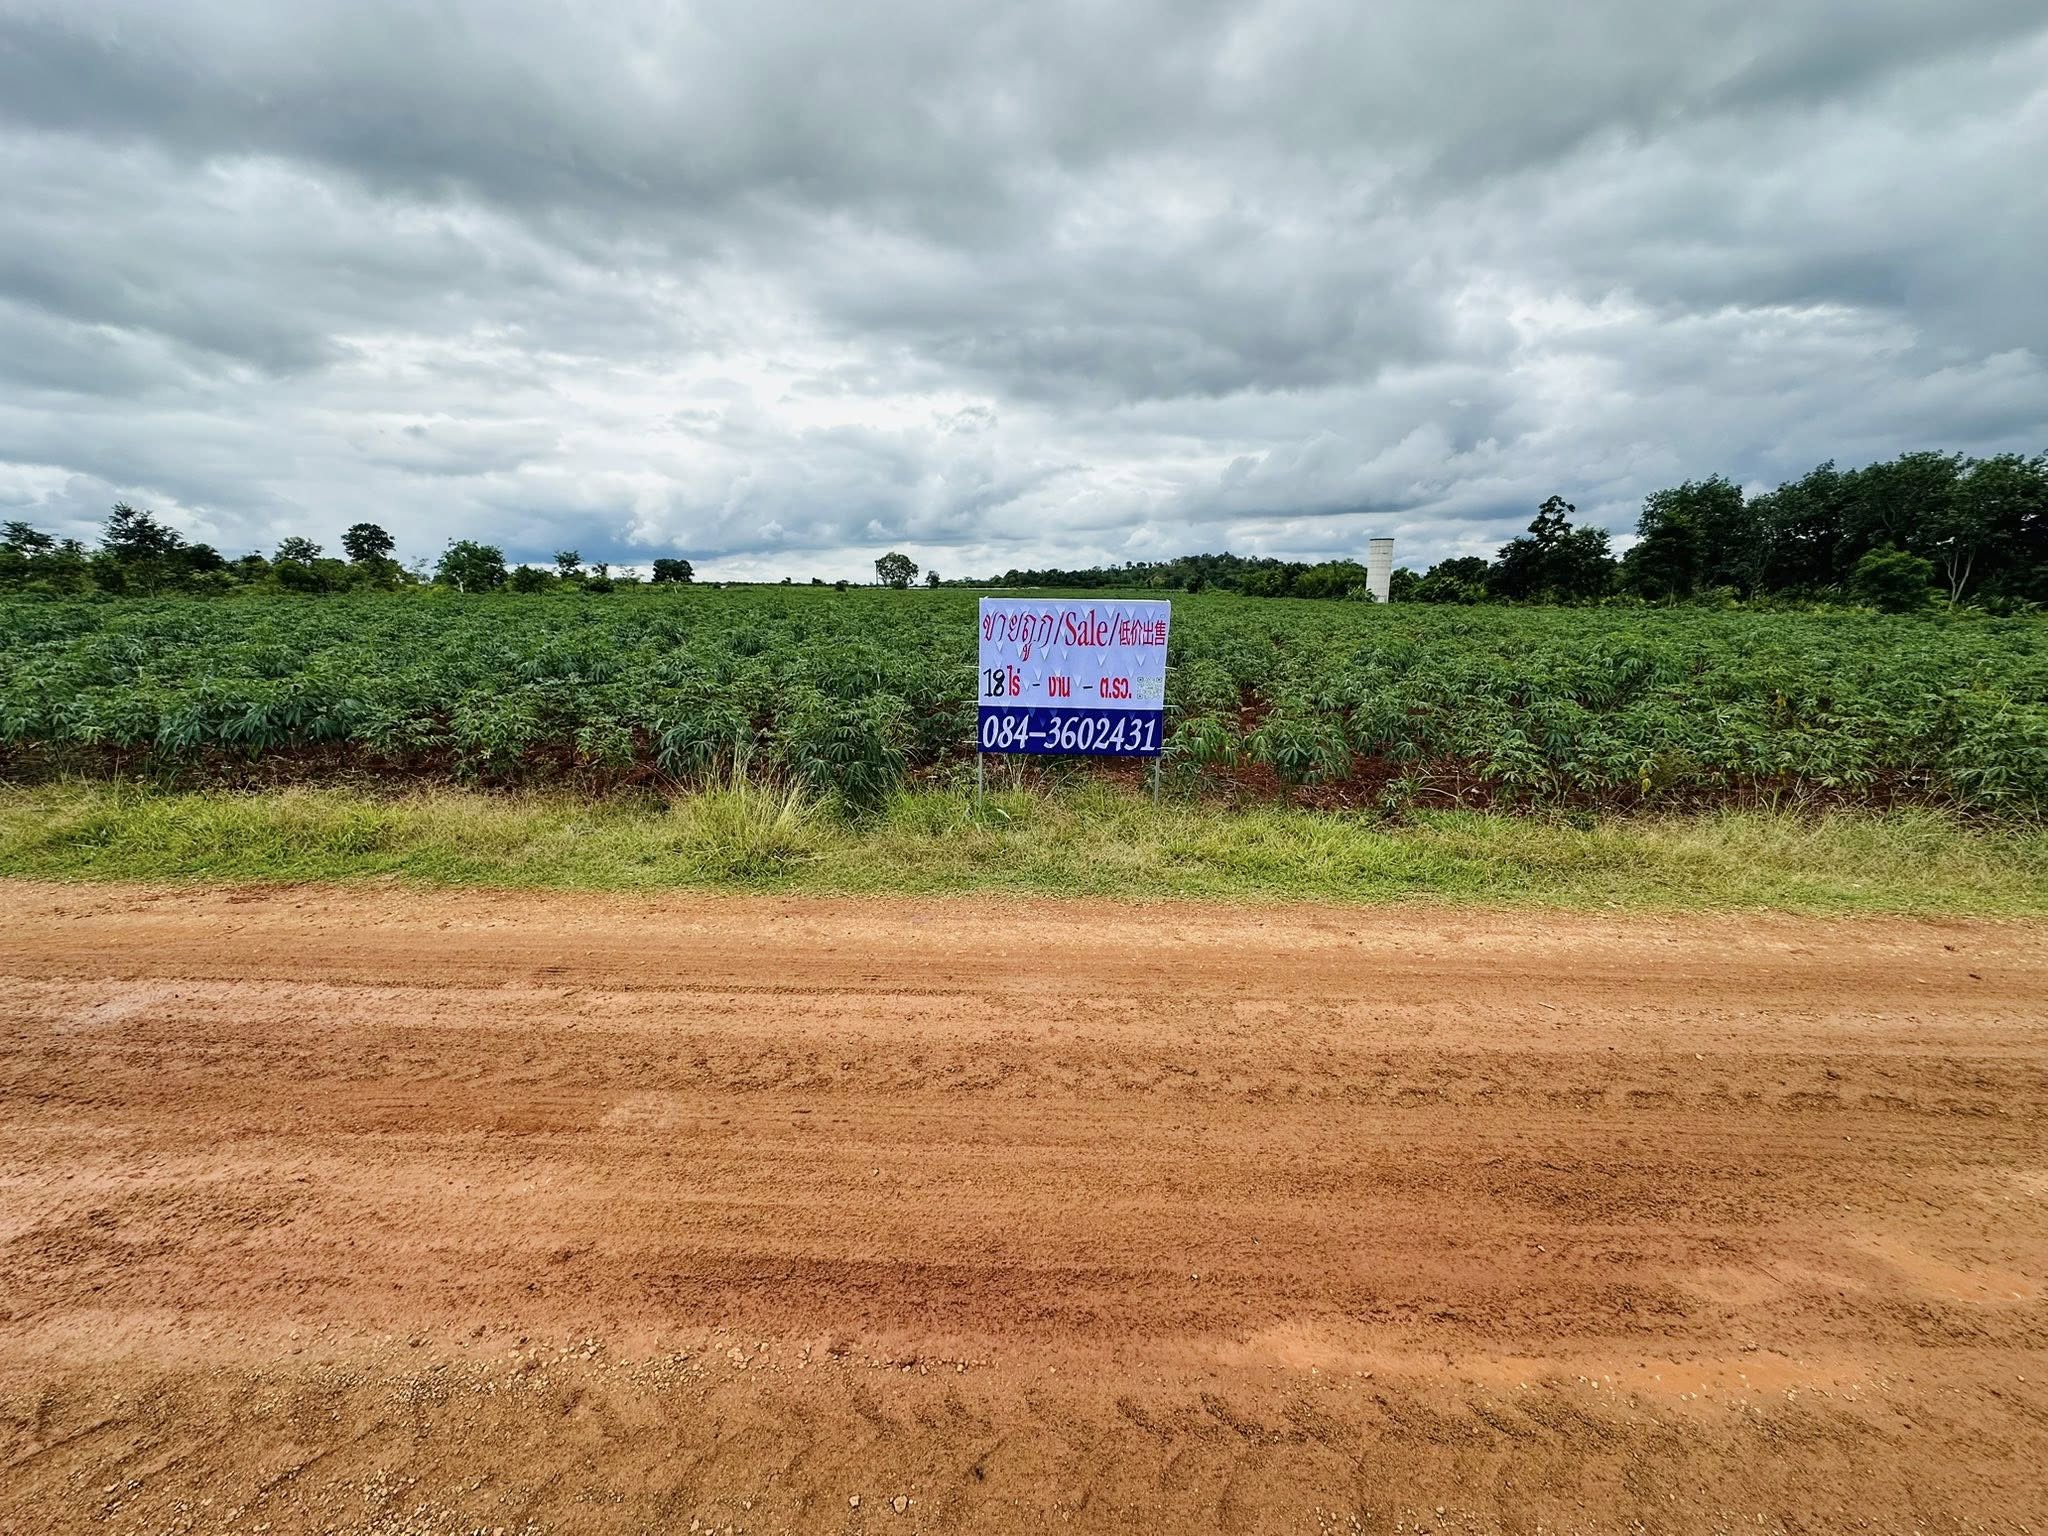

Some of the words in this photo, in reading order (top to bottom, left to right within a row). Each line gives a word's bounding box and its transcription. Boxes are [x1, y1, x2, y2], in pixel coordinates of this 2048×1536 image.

[983, 668, 1005, 697] 18
[1007, 665, 1020, 696] ไร่
[1048, 676, 1070, 697] งาน
[982, 714, 1156, 751] 084-3602431
